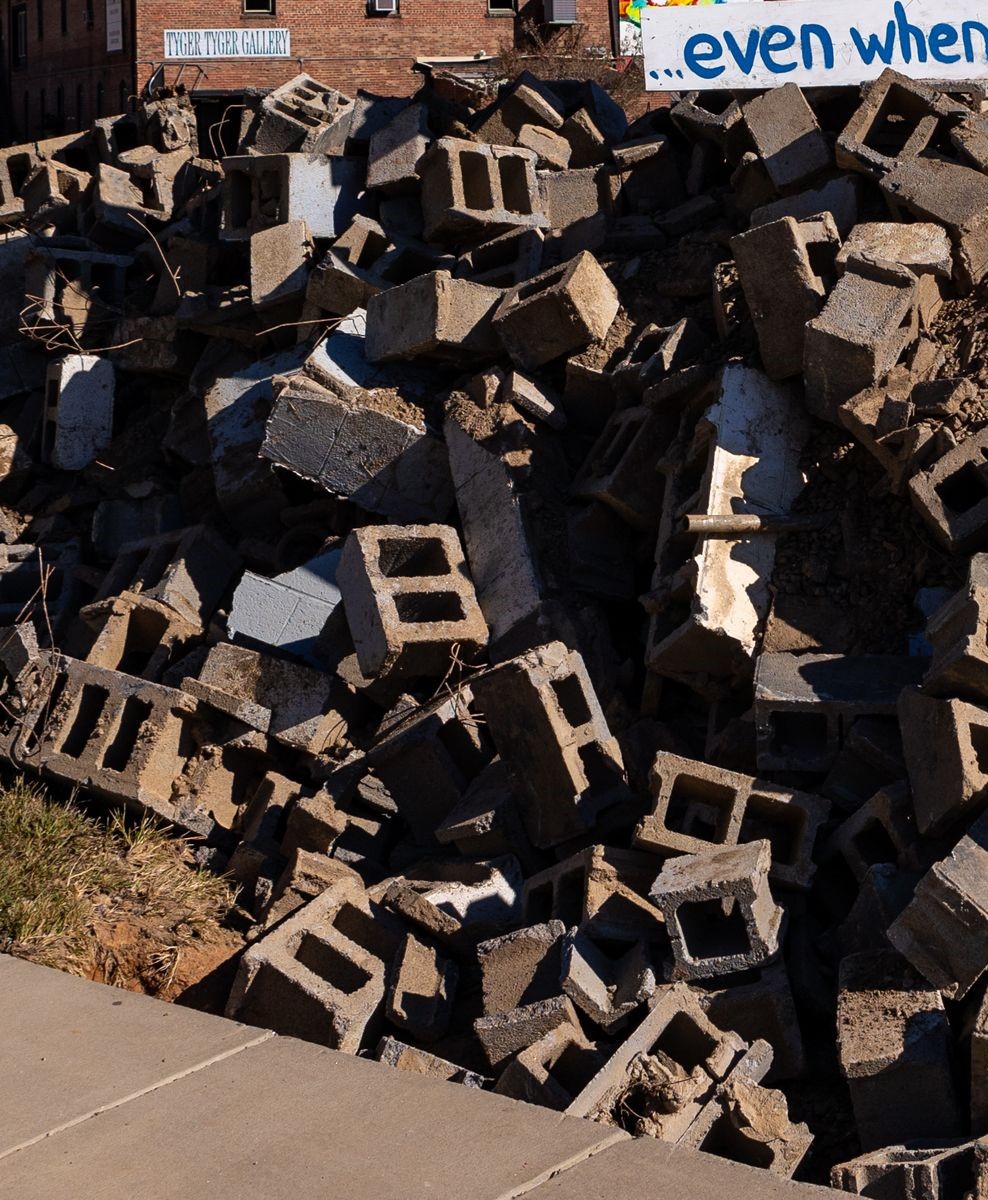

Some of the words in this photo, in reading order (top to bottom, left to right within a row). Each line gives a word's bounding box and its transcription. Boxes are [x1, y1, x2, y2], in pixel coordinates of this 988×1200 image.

[166, 31, 201, 56] TYGER
[204, 30, 239, 55] TYGER
[241, 30, 288, 55] GALLERY
[649, 23, 834, 80] ...even
